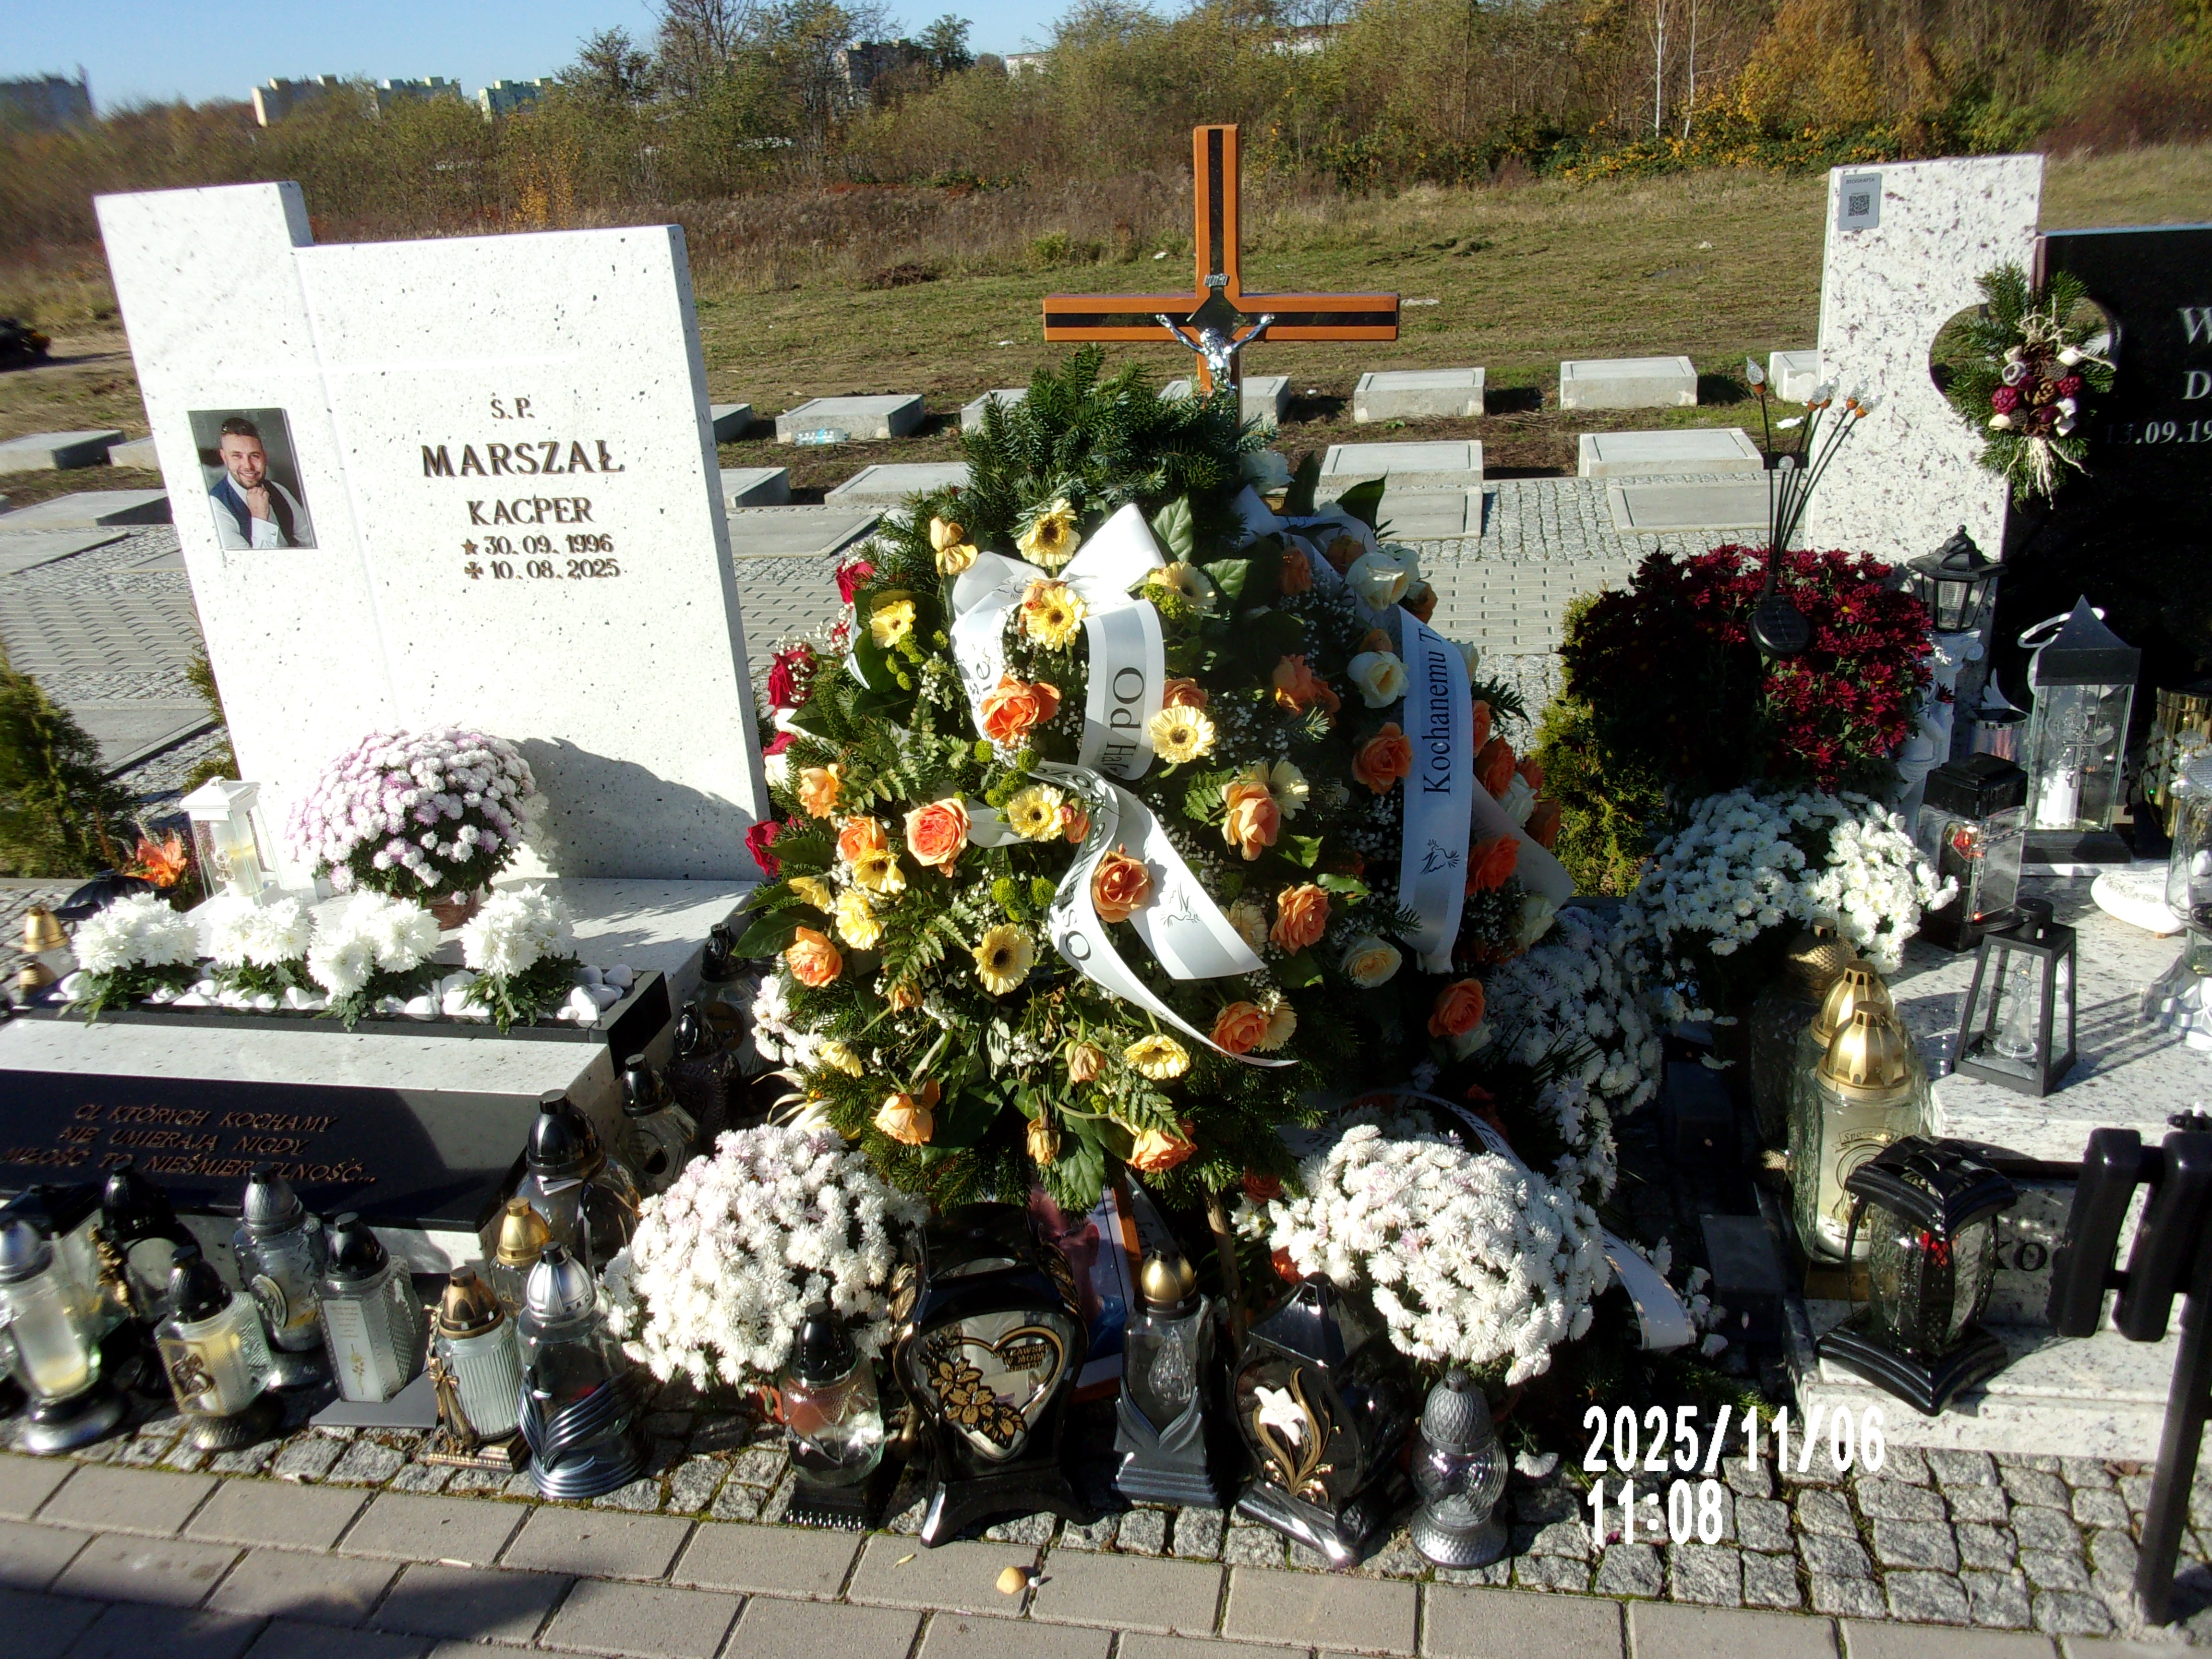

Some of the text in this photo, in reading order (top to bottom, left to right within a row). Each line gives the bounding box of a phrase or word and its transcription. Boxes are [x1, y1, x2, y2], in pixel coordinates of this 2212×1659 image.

[421, 439, 625, 478] MARSZAŁ
[466, 496, 595, 526] KACPER
[1421, 650, 1451, 794] Kochanemu
[108, 1103, 212, 1127] KTÓRYCH
[219, 1111, 337, 1132] KOCHAMY
[58, 1126, 100, 1143] NIE
[232, 1136, 312, 1156] NIGDY
